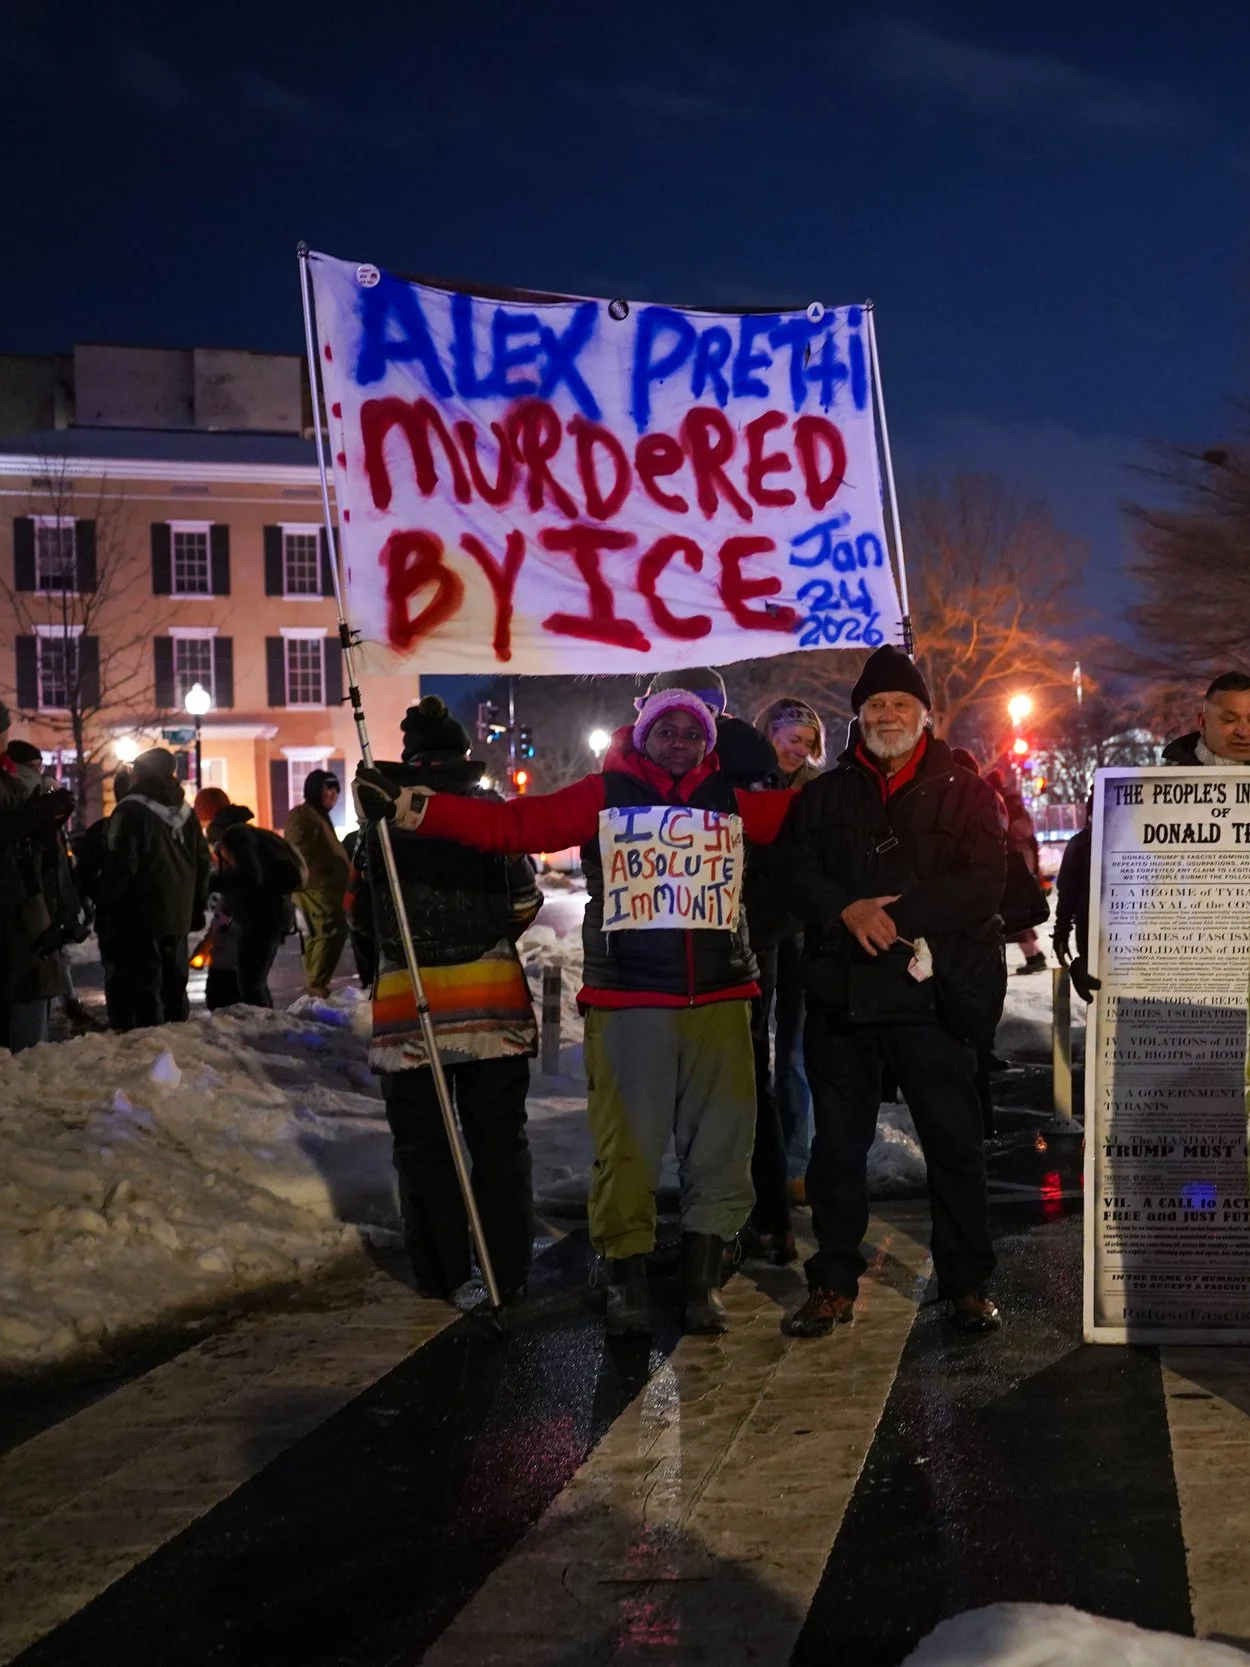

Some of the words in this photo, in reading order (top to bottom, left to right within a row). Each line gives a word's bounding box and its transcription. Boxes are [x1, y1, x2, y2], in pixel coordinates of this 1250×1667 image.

[355, 269, 602, 421] ALEX
[789, 511, 884, 573] Jan
[378, 528, 525, 662] BY
[539, 525, 796, 653] ICE
[797, 577, 874, 617] 24
[797, 612, 884, 648] 2026
[1114, 783, 1144, 805] THE
[1152, 783, 1227, 805] PEOPLE'S
[1211, 807, 1231, 818] OF
[1143, 823, 1221, 844] DONALD
[610, 847, 735, 884] ABSOLUTE
[1127, 889, 1135, 897] A
[1141, 888, 1197, 897] REGIME
[1200, 887, 1212, 897] of
[1110, 901, 1187, 910] BETRAYAL
[1190, 900, 1204, 909] of
[1206, 900, 1224, 909] the
[1129, 932, 1180, 941] CRIMES
[1182, 932, 1193, 941] of
[1107, 945, 1213, 954] CONSOLIDATION
[1216, 945, 1227, 954] of
[1130, 997, 1138, 1005] A
[1142, 996, 1194, 1006] HISTORY
[1197, 996, 1207, 1005] of
[1130, 1037, 1207, 1046] VIOLATIONS
[1210, 1037, 1221, 1046] of
[1104, 1051, 1141, 1060] CIVIL
[1145, 1051, 1193, 1060] RIGHTS
[1195, 1051, 1206, 1060] at
[1125, 1089, 1134, 1098] A
[1137, 1089, 1238, 1098] GOVERNMENT
[1103, 1102, 1169, 1111] TYRANTS
[1157, 1136, 1227, 1145] MANDATE
[1230, 1136, 1242, 1145] of
[1103, 1145, 1175, 1158] TRUMP
[1183, 1145, 1236, 1158] MUST
[1103, 1197, 1131, 1208] VII.
[1143, 1197, 1153, 1208] A
[1158, 1197, 1195, 1209] CALL
[1200, 1197, 1217, 1209] to
[1103, 1211, 1140, 1222] FREE
[1147, 1211, 1177, 1222] and
[1183, 1212, 1217, 1223] JUST
[1150, 1274, 1181, 1282] NAME
[1184, 1274, 1199, 1282] OF
[1149, 1282, 1192, 1290] ACCEPT
